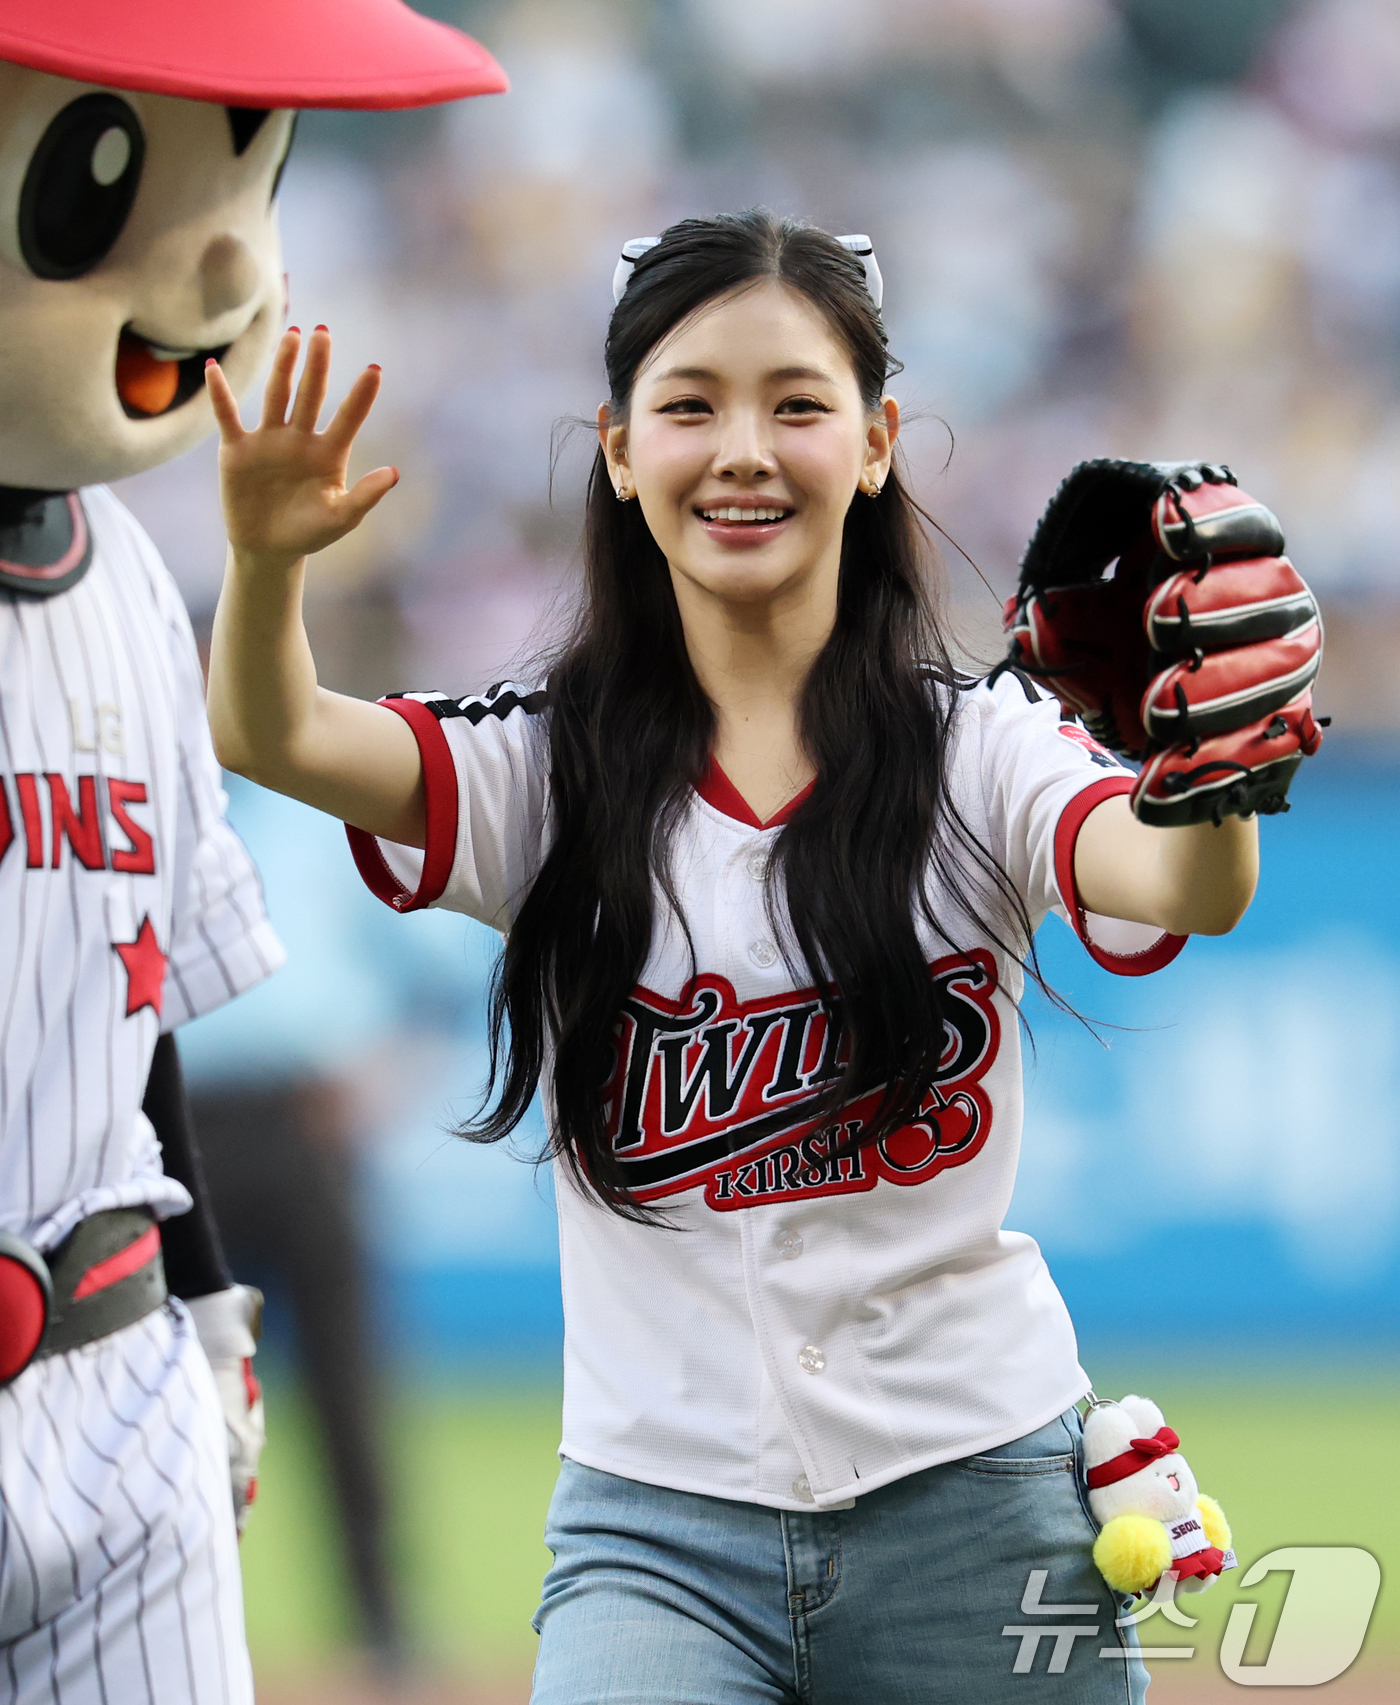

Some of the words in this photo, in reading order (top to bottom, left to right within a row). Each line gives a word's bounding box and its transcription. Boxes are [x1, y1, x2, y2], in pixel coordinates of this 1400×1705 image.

[69, 696, 126, 757] LG
[0, 772, 155, 875] INS
[716, 1120, 866, 1200] KIRSH
[1171, 1518, 1201, 1540] SEOUL
